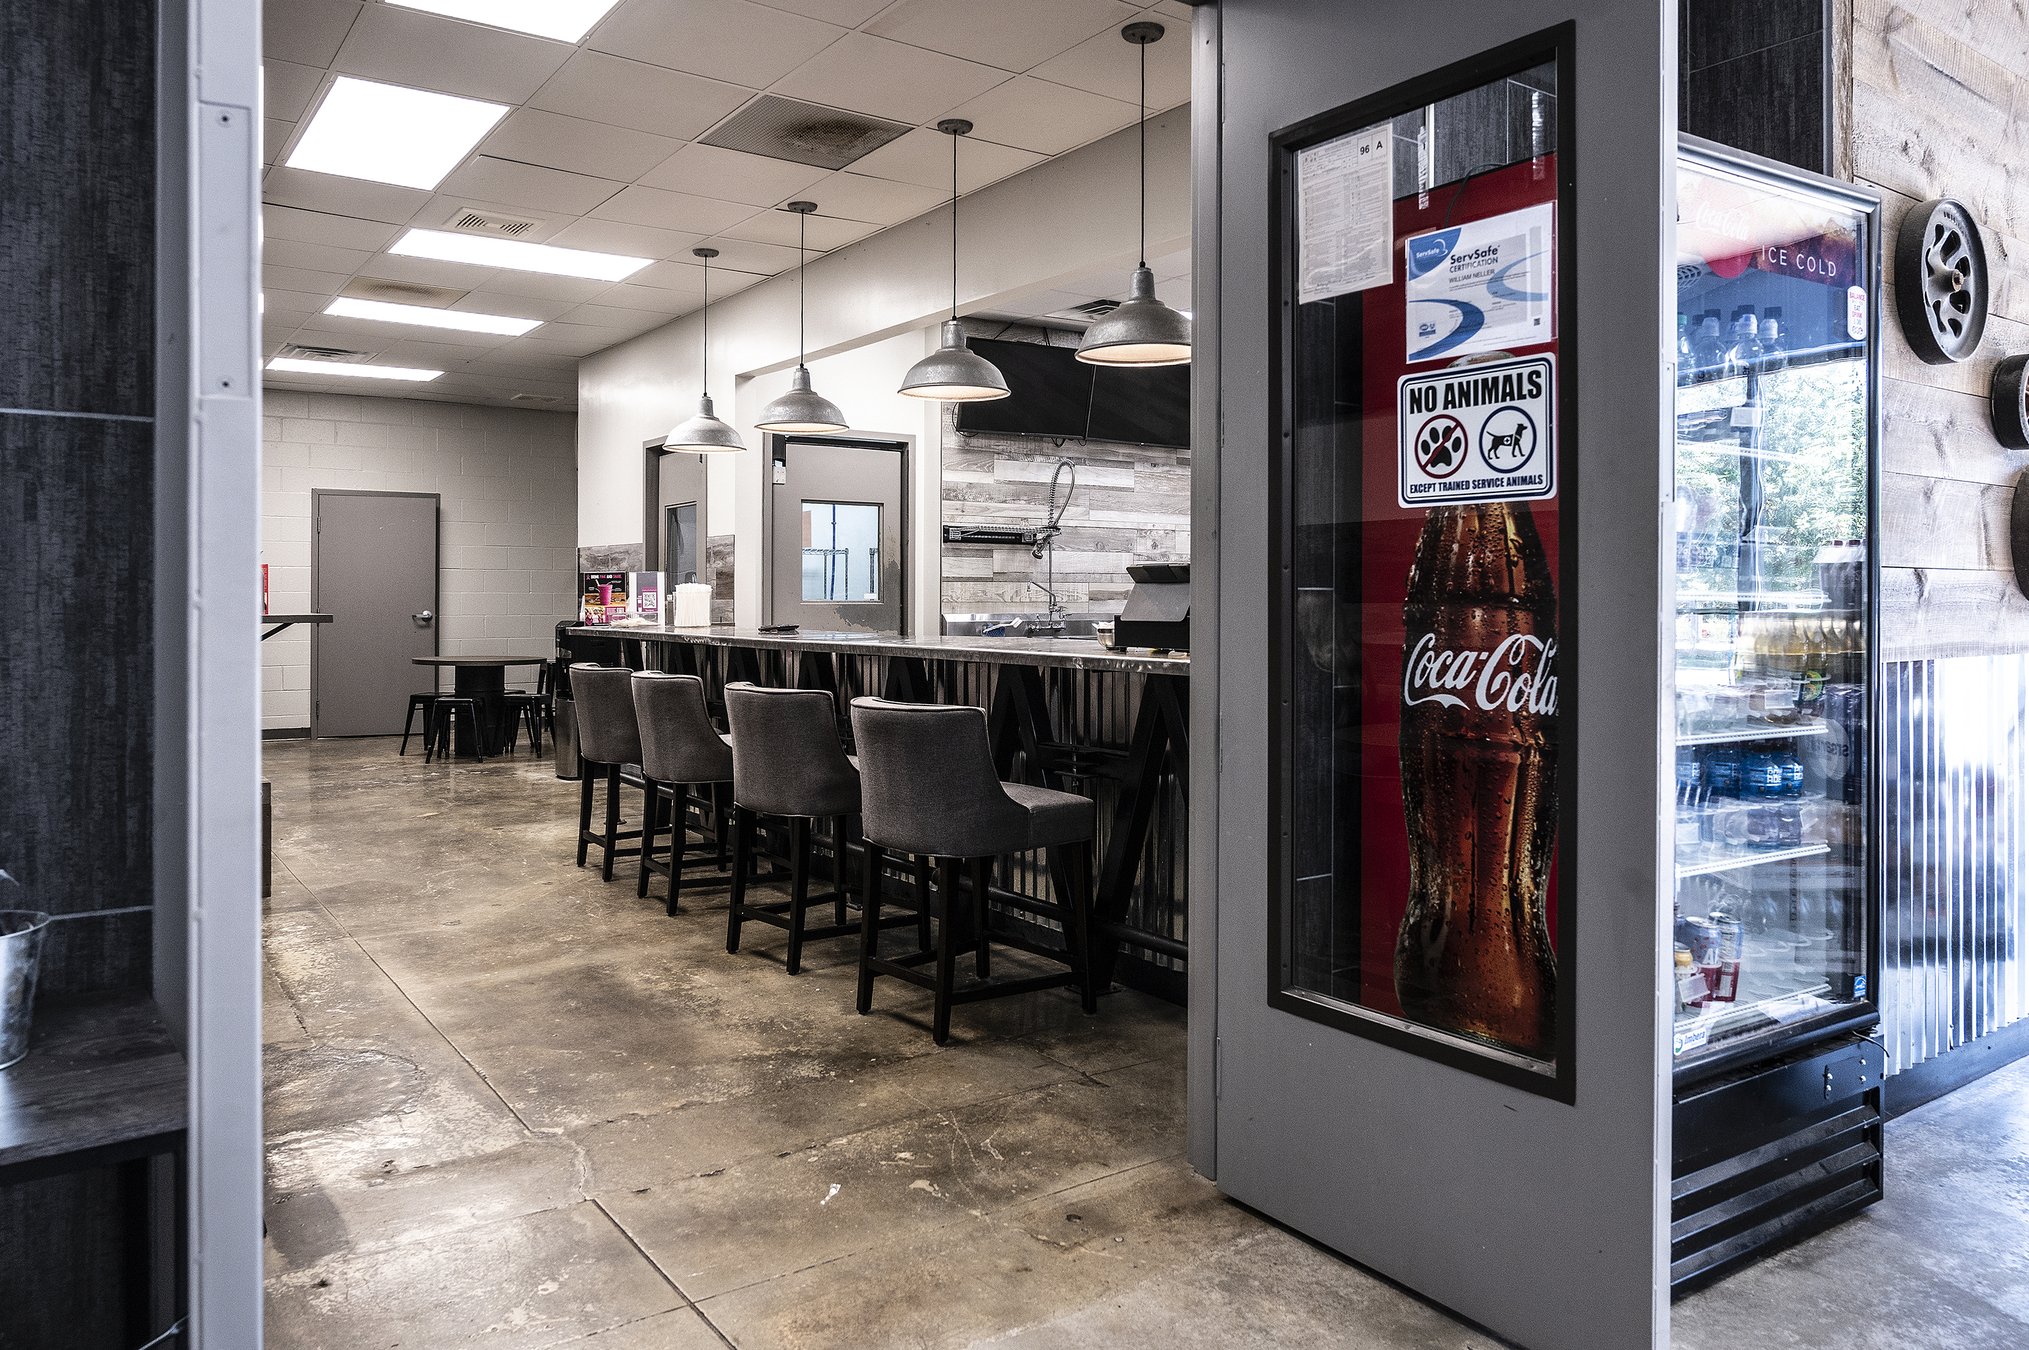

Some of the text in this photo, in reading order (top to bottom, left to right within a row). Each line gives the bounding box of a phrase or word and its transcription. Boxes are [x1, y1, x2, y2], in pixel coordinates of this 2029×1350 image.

[1360, 141, 1383, 155] 96 A
[1416, 247, 1440, 258] ServSafe
[1762, 245, 1836, 276] ICE COLD
[1449, 257, 1498, 273] CERTIFICATION
[1449, 275, 1472, 283] WILLIAM
[1409, 370, 1542, 414] NO ANIMALS
[1410, 474, 1543, 493] EXCEPT TRAINED SERVICE ANIMALS
[1404, 633, 1558, 715] Coca-Cola
